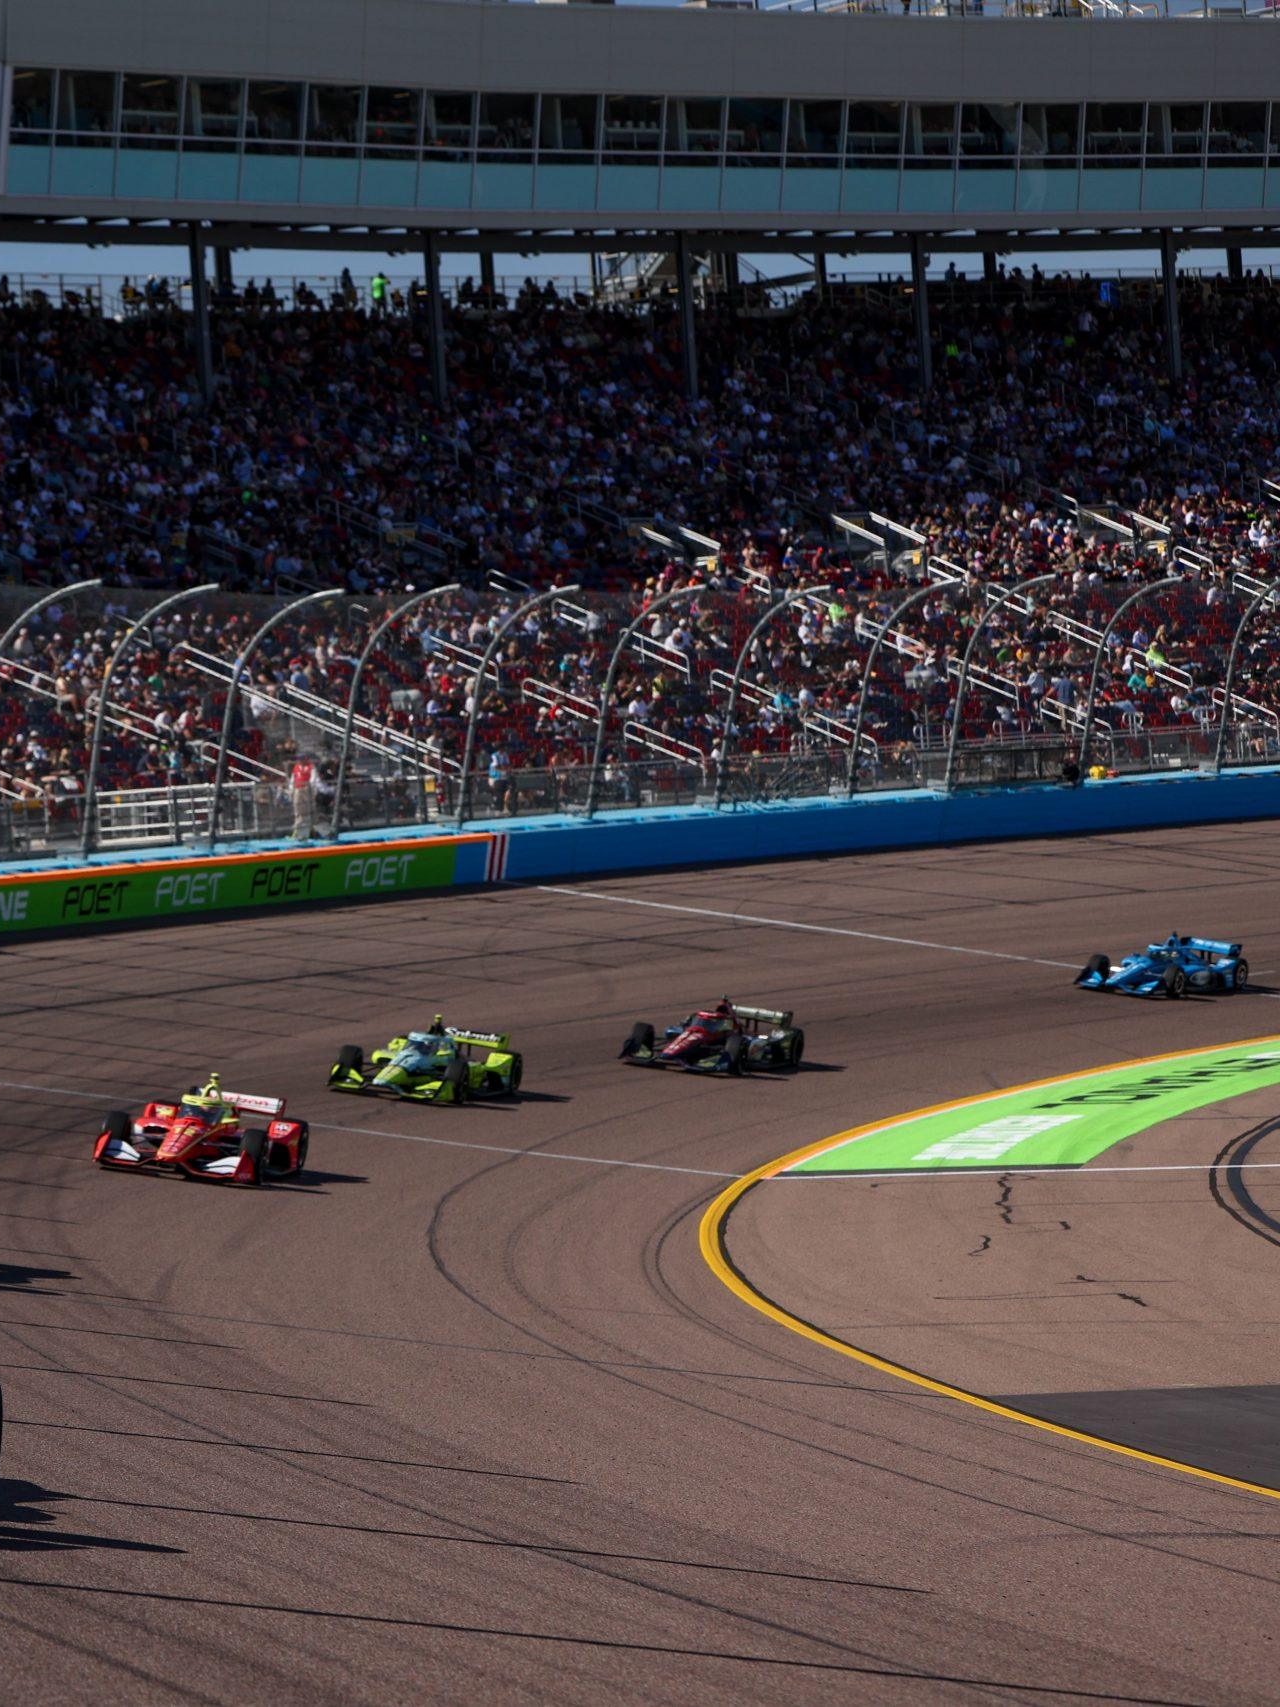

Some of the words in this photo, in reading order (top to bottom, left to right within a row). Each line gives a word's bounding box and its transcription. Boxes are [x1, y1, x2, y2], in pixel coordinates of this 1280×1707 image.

[61, 881, 131, 918] POET
[154, 872, 226, 908] POET
[250, 863, 319, 898] POET
[345, 854, 417, 889] POET
